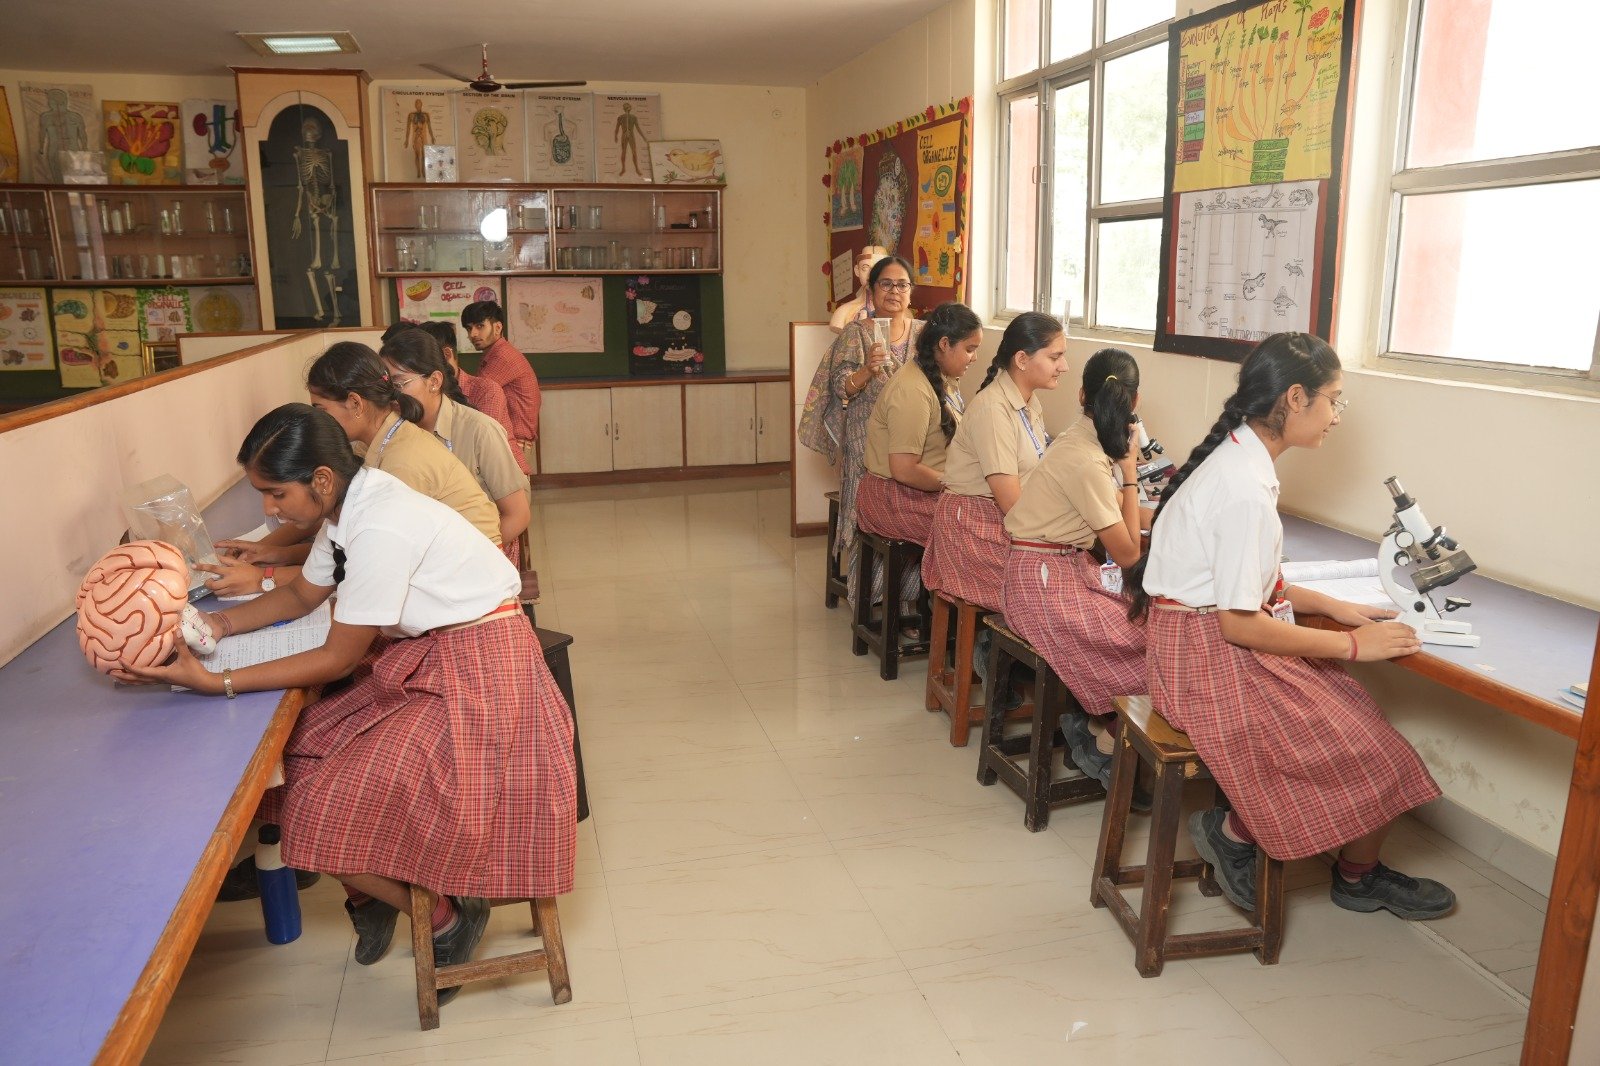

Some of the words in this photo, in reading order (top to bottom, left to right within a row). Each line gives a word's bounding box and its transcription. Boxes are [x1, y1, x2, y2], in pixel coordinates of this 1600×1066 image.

[919, 134, 934, 150] CELL
[922, 145, 958, 164] ORGANELLES
[442, 281, 467, 292] CELL
[157, 293, 174, 301] CELL
